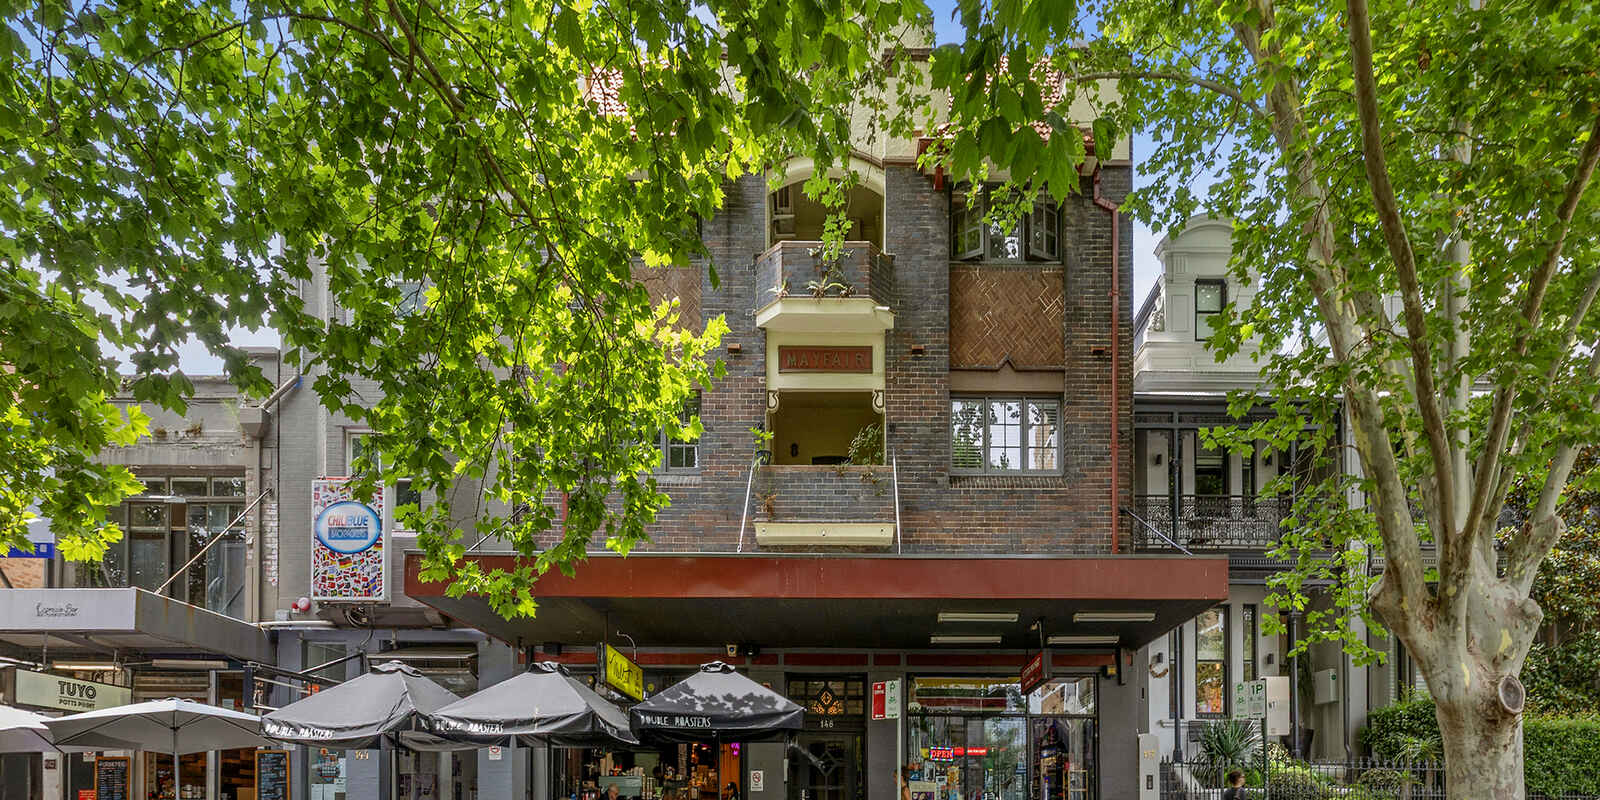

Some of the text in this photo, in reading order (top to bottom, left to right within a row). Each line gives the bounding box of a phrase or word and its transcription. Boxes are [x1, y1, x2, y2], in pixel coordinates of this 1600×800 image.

[786, 352, 865, 367] MAYFAIR
[58, 680, 97, 699] TUYO
[1251, 684, 1263, 695] 1P
[59, 699, 95, 709] POTTS POINT
[641, 715, 712, 728] DOUBLE ROASTERS
[264, 723, 334, 741] DOUBLE ROASTERS
[467, 722, 504, 735] ROASTERS
[931, 750, 954, 759] OPEN
